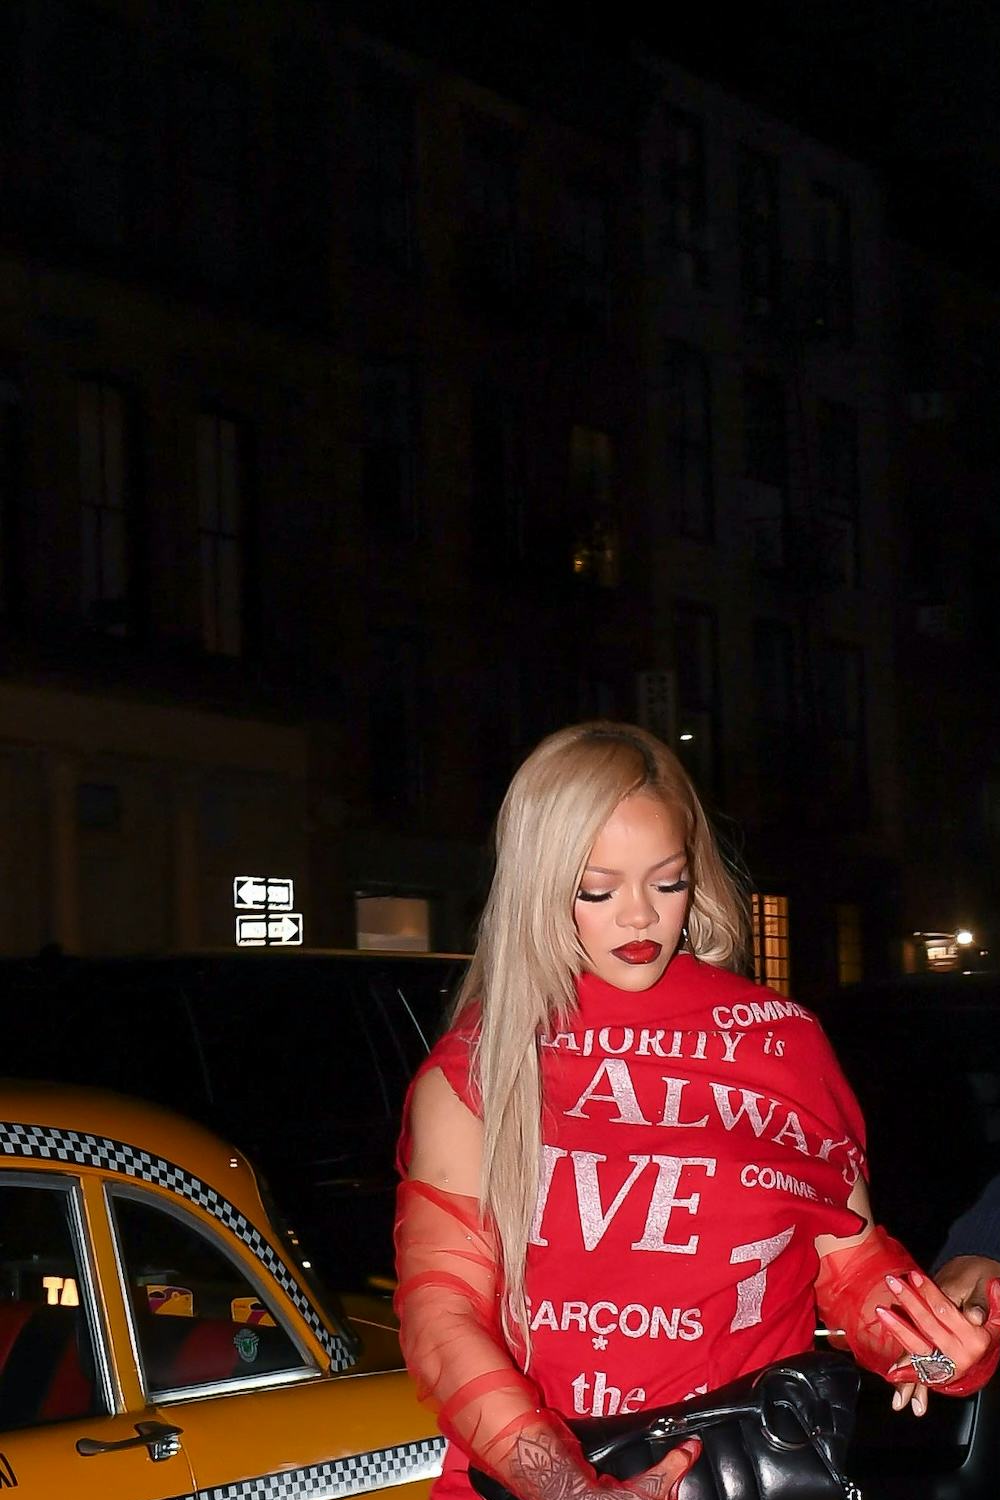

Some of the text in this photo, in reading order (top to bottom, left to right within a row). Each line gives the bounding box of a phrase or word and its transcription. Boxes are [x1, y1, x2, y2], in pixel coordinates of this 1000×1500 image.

[712, 1000, 813, 1029] COMME
[541, 1026, 785, 1063] AJORITY is
[528, 1144, 717, 1255] IVE
[43, 1276, 80, 1307] TA
[571, 1371, 646, 1417] the
